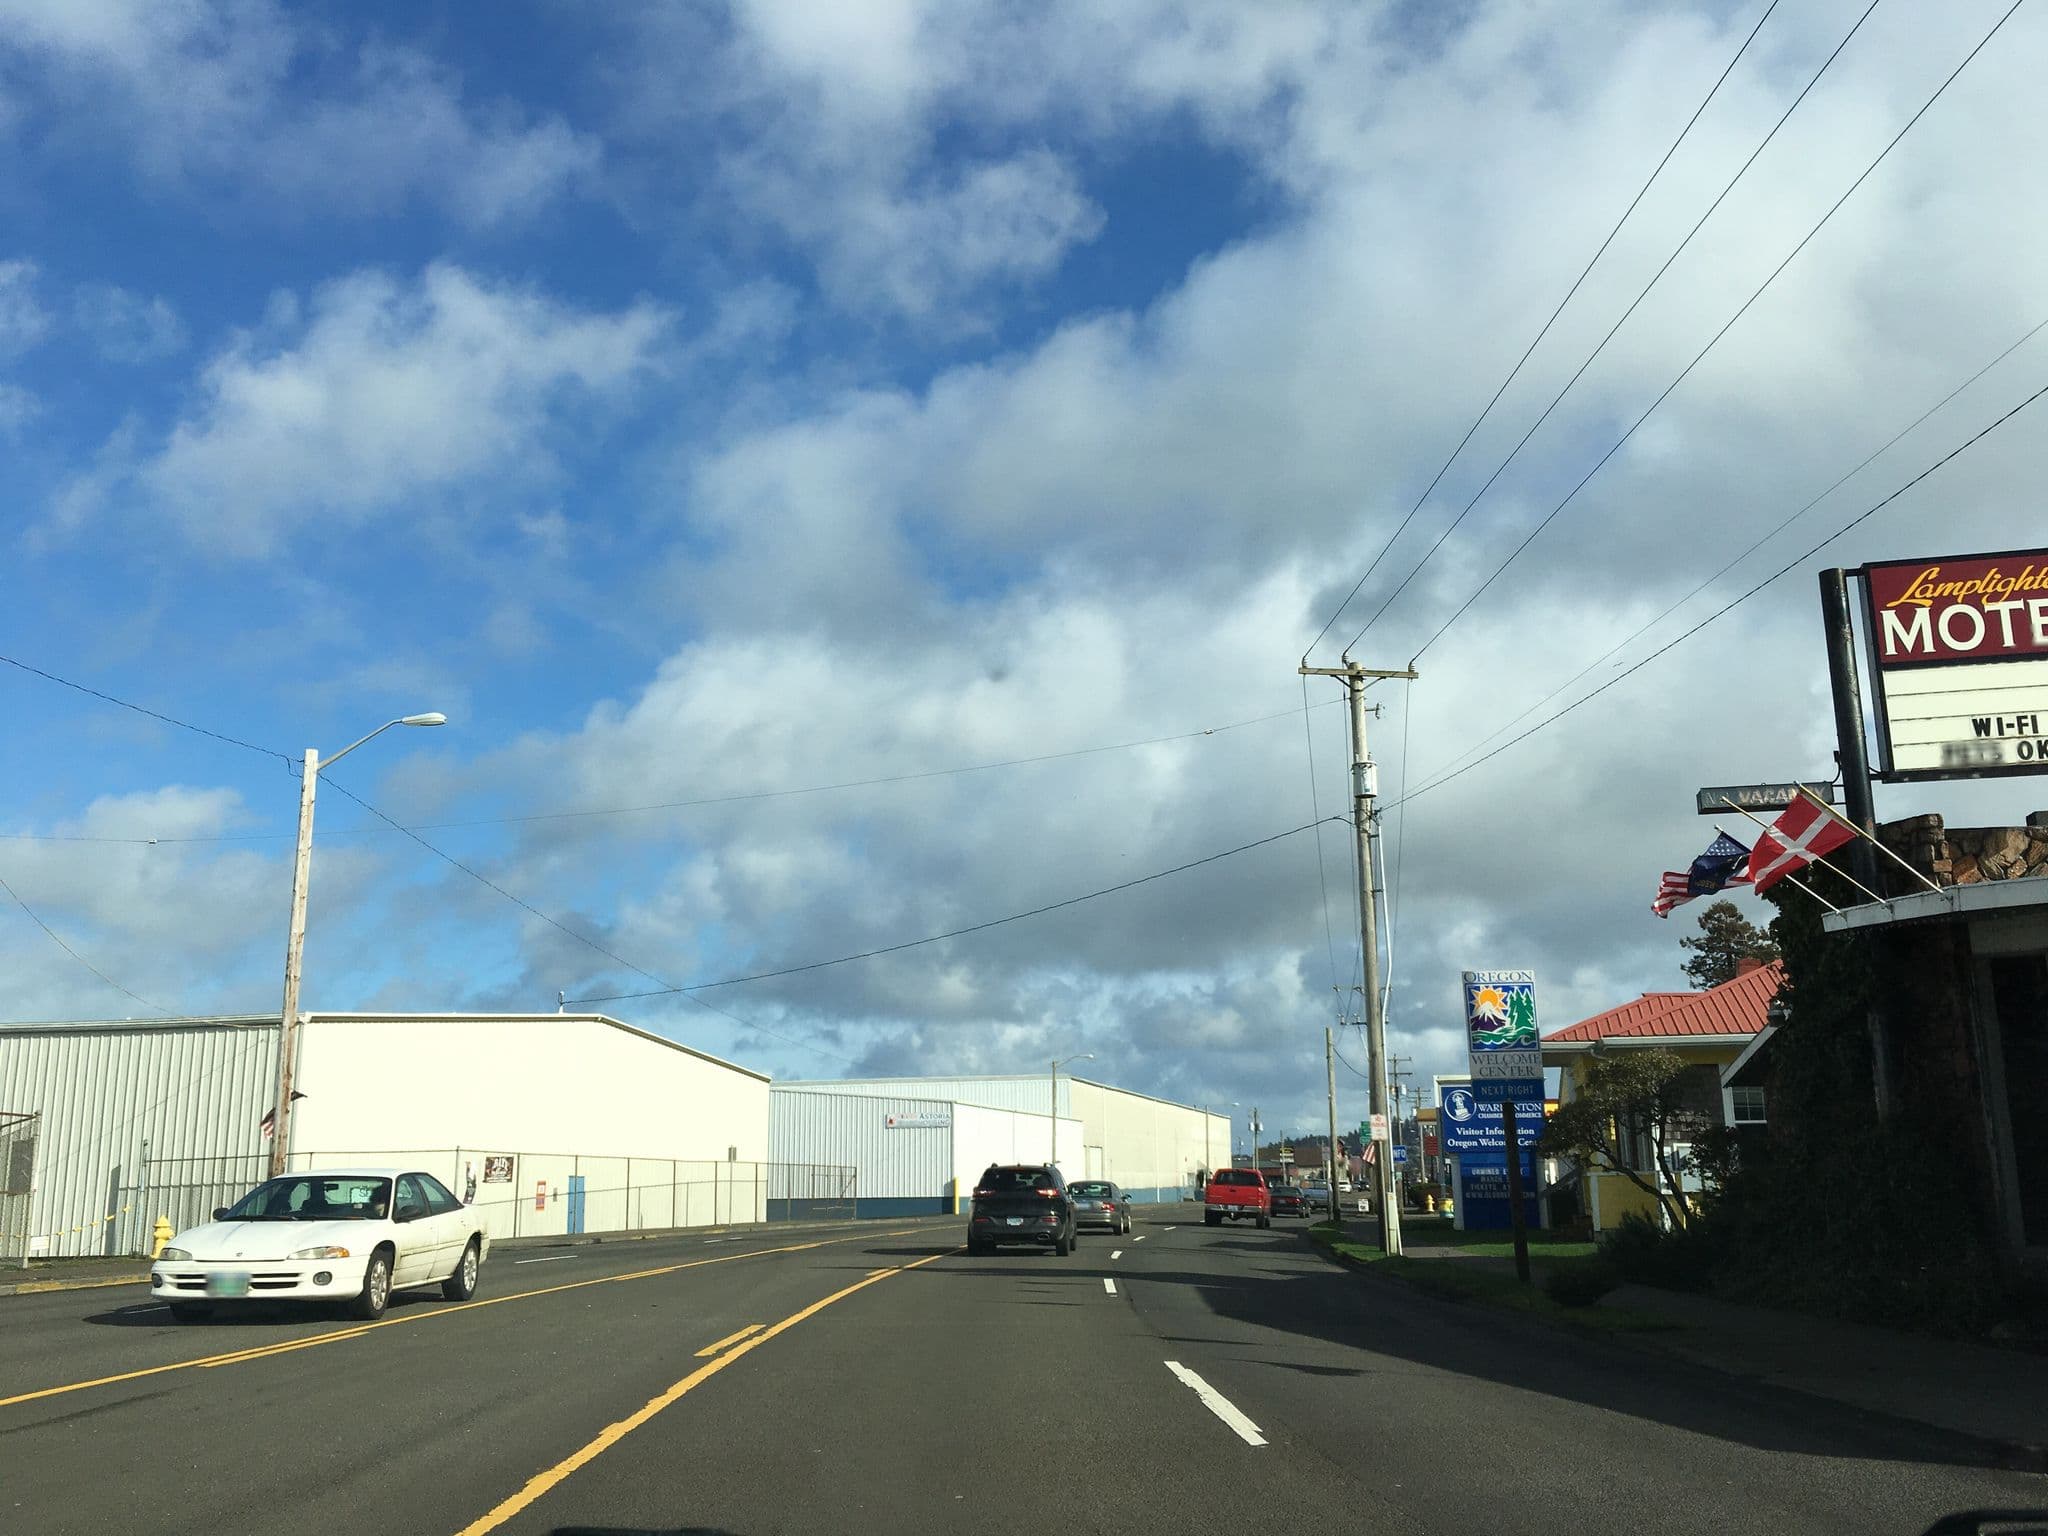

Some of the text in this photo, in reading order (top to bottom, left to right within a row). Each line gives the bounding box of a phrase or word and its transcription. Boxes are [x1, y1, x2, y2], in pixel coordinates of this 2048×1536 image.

[1880, 598, 2048, 656] MOTE
[1971, 714, 2039, 738] WI-FI
[1738, 787, 1826, 805] VACANY
[1463, 971, 1534, 983] OREGON
[1471, 1054, 1541, 1066] WELCOME
[1479, 1066, 1535, 1078] CENTER
[1481, 1085, 1534, 1096] NEXT RIGHT
[1456, 1127, 1484, 1136] Visitor
[1447, 1138, 1478, 1148] Oregon
